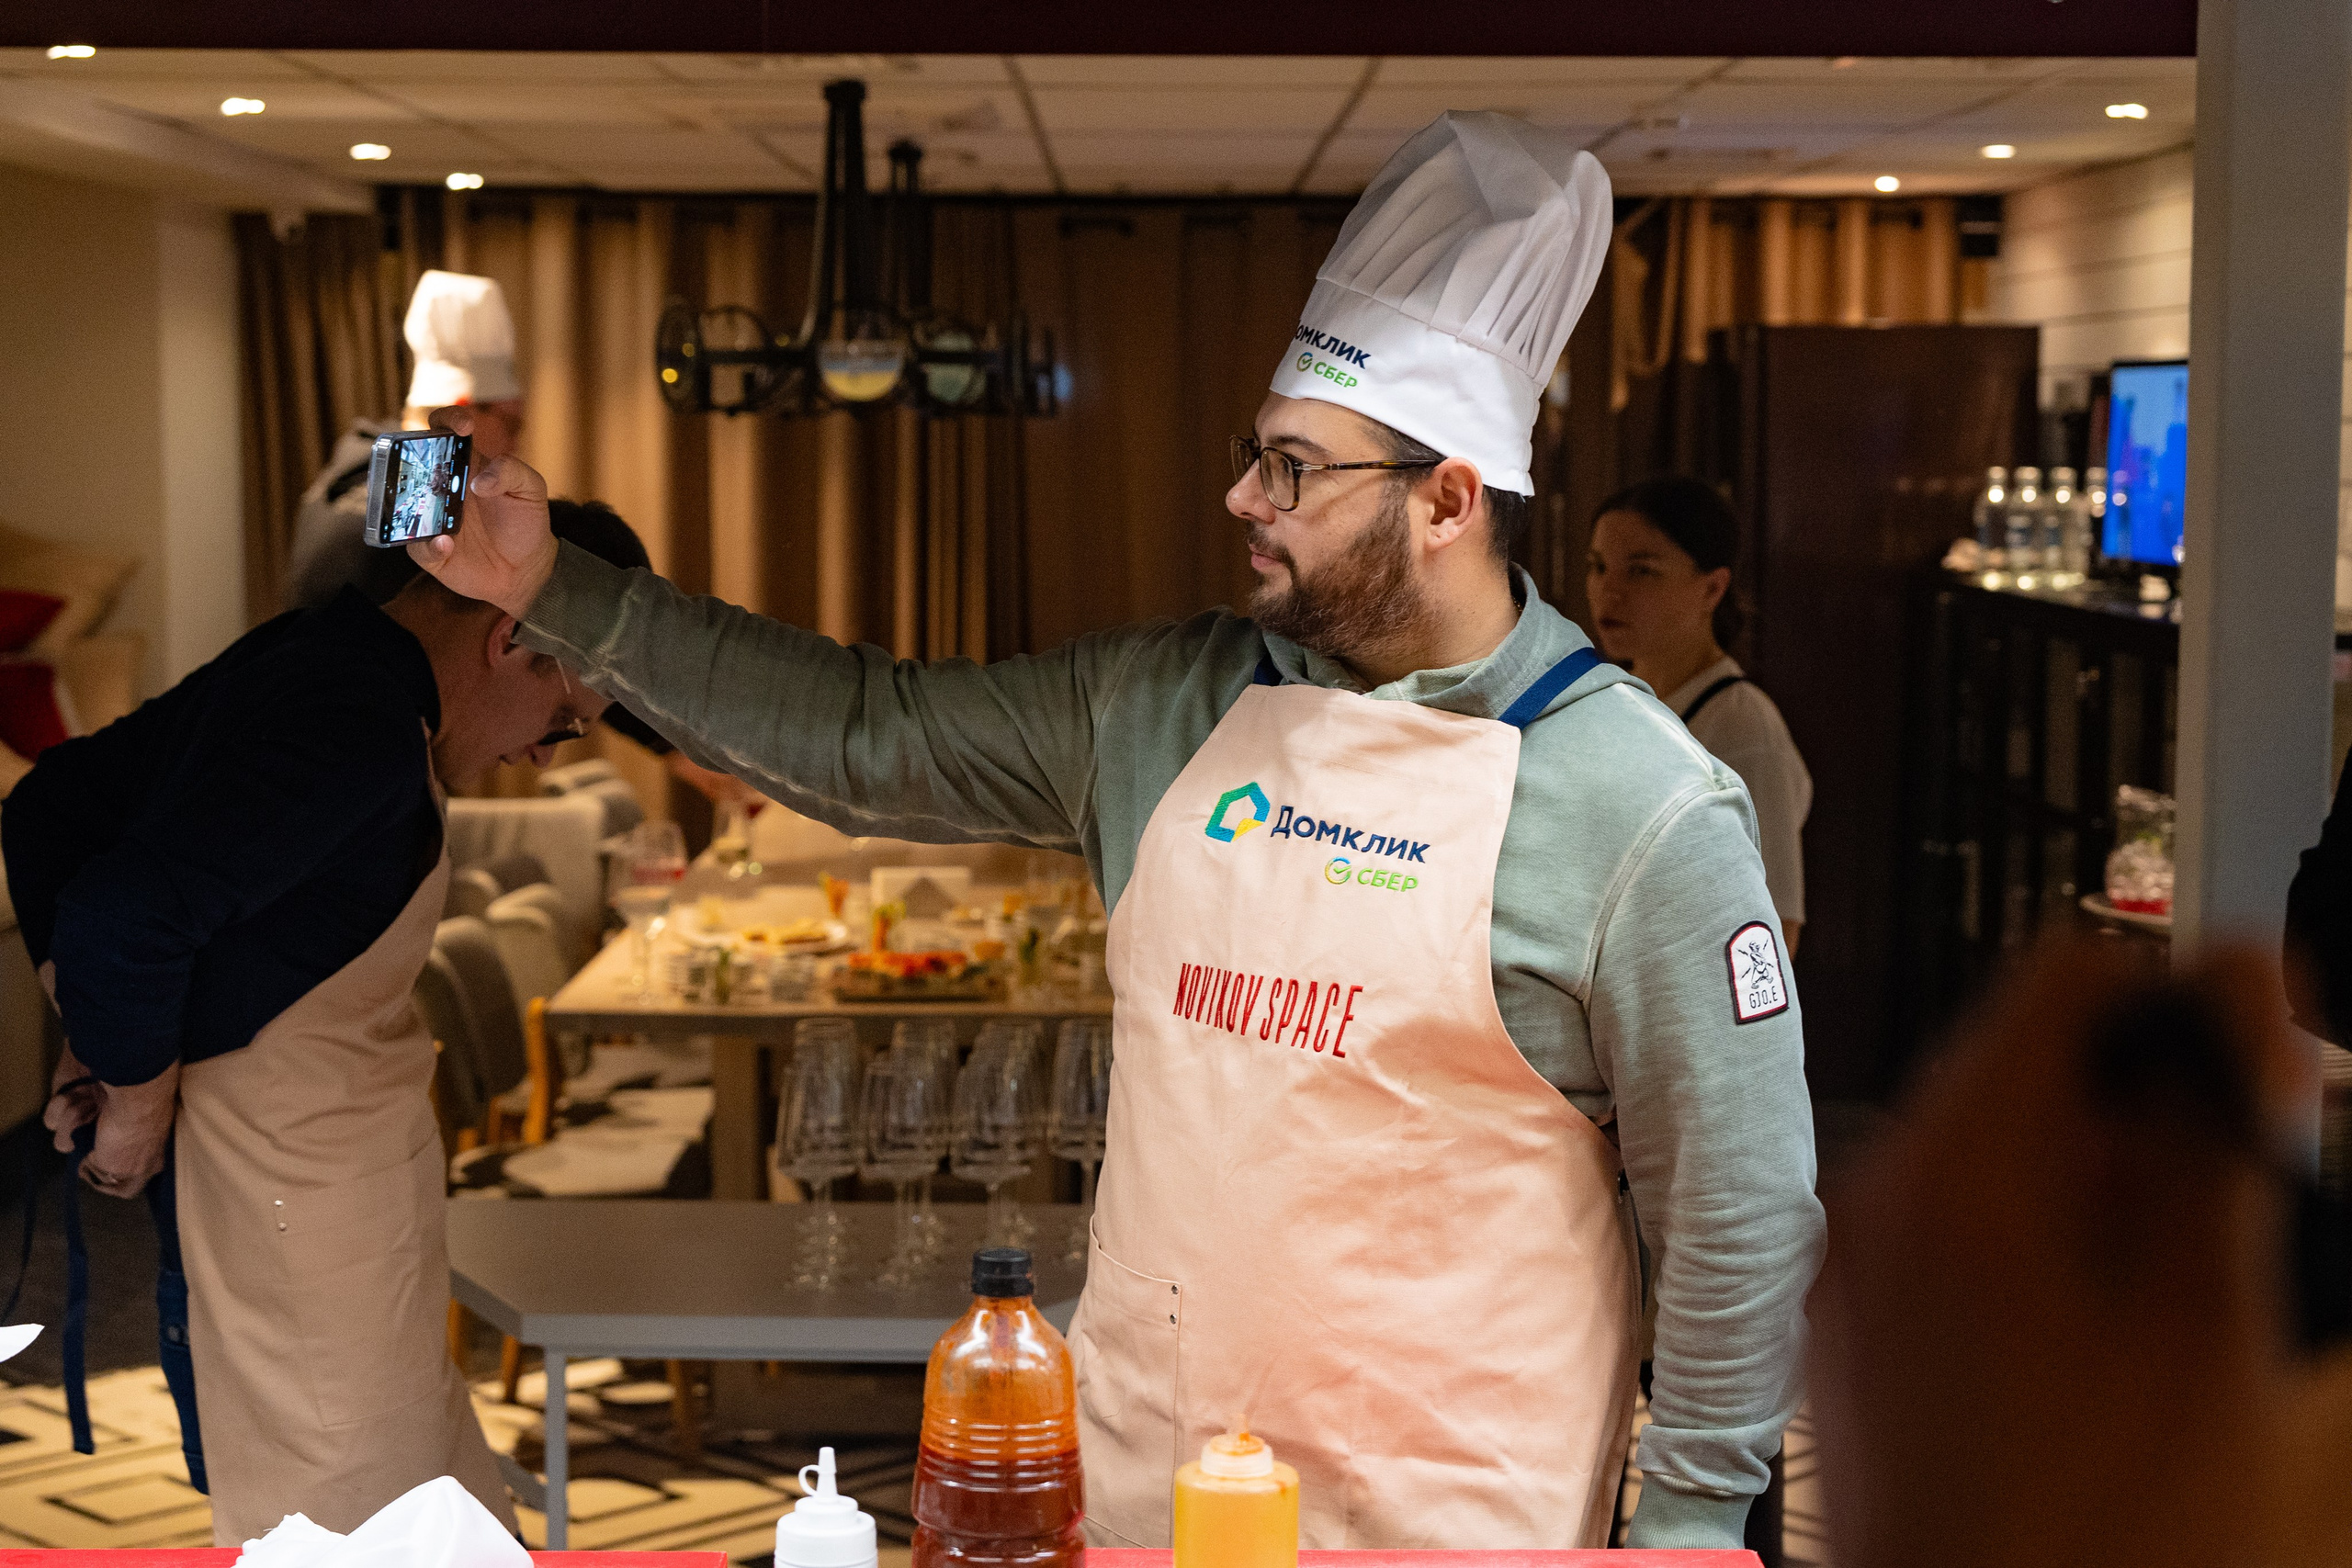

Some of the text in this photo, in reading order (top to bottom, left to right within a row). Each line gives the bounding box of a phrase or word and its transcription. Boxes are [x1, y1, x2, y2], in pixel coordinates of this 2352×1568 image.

[1295, 324, 1372, 369] омклик
[1314, 361, 1358, 388] СБЕР
[1357, 867, 1419, 892] СБЕР
[1172, 962, 1364, 1058] NOVIKOV SPACE
